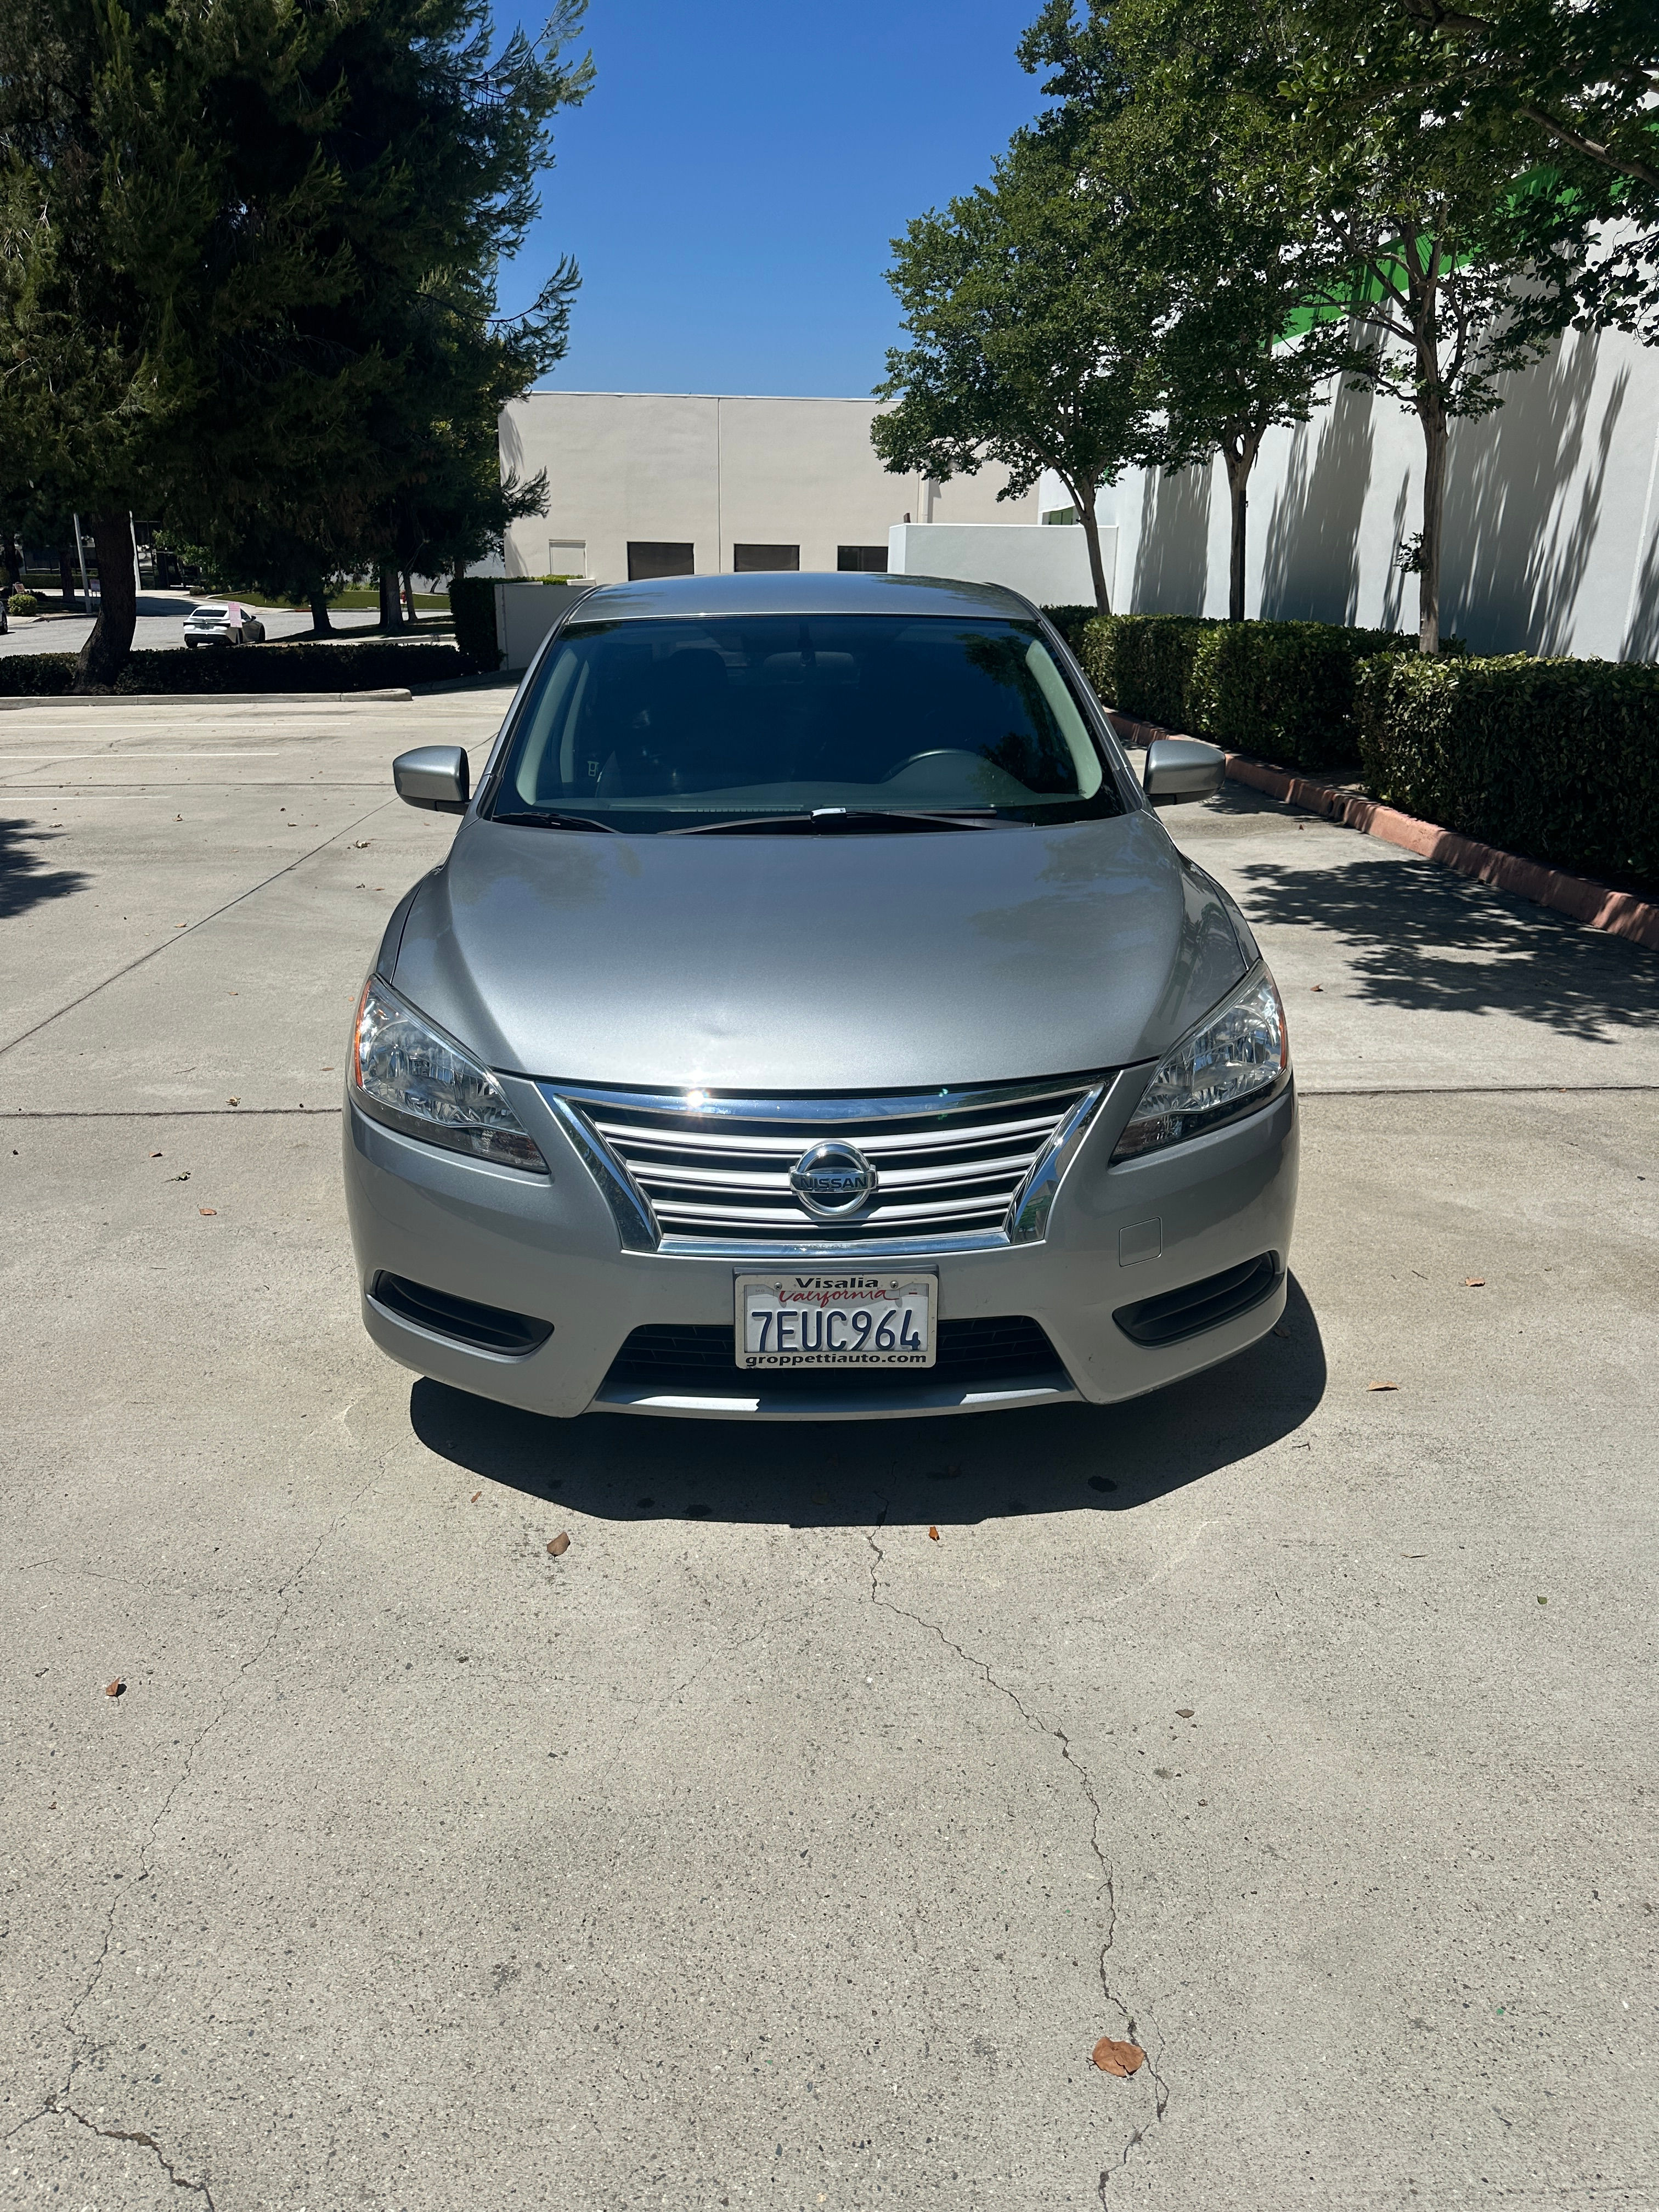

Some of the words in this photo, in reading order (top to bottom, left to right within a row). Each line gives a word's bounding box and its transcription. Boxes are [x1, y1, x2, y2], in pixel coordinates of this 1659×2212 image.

[800, 1176, 867, 1190] NISSAN
[795, 1278, 879, 1289] Visalia
[779, 1289, 900, 1308] California
[751, 1310, 921, 1352] 7EUC964
[745, 1354, 927, 1367] groppettiauto.com
